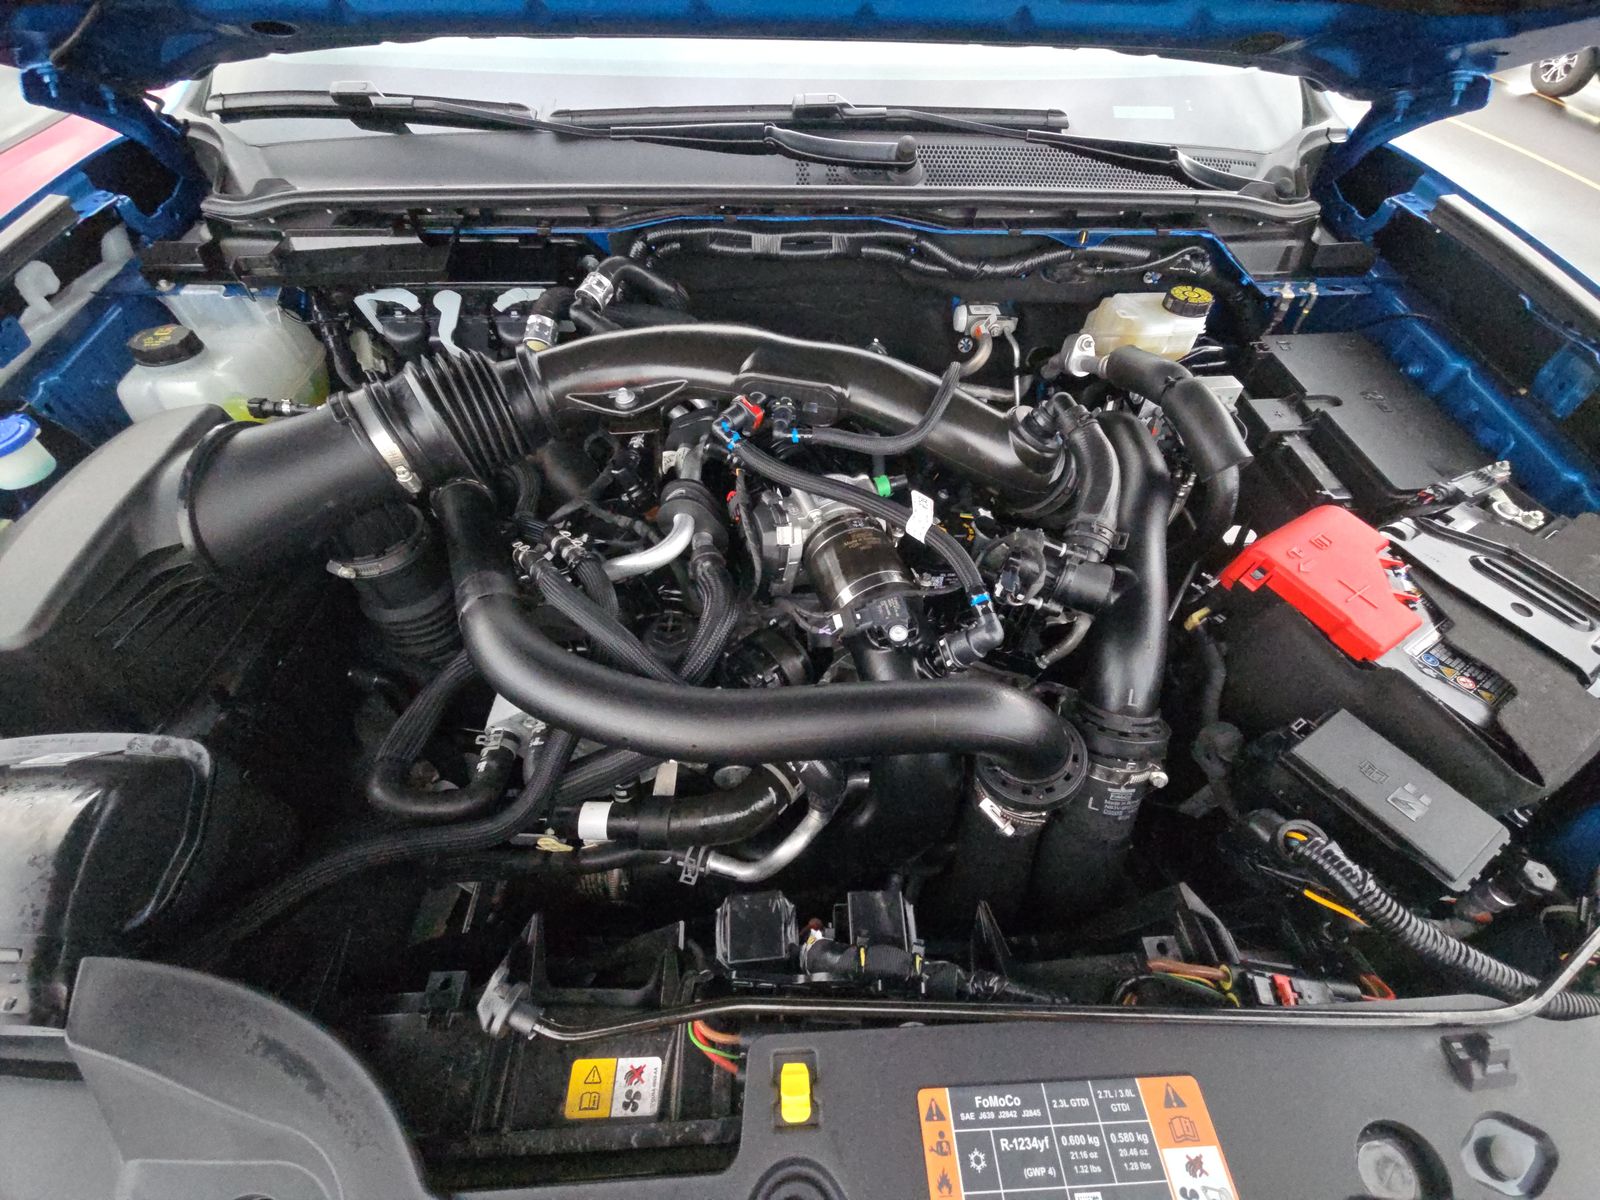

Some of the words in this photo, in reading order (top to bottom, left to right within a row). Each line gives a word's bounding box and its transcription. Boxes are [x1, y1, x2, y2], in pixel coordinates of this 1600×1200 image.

[1097, 1089, 1114, 1099] 2.7L
[974, 1094, 1022, 1108] FoMoCo
[1052, 1099, 1069, 1109] 2.3L
[1069, 1097, 1090, 1107] GTDI
[1110, 1103, 1131, 1112] GTDI
[960, 1112, 976, 1121] SAE
[978, 1111, 995, 1120] J639
[1061, 1134, 1086, 1146] 0.600
[1086, 1134, 1100, 1147] kg
[1110, 1132, 1135, 1143] 0.580
[1135, 1131, 1150, 1144] kg
[999, 1135, 1050, 1153] R-1234yf
[1070, 1151, 1088, 1160] 21.16
[1089, 1151, 1099, 1159] oz
[1118, 1148, 1139, 1157] 20.46
[1074, 1165, 1089, 1174] 1.32
[1089, 1164, 1102, 1173] lbs
[1124, 1162, 1139, 1171] 1.28
[1139, 1162, 1152, 1170] lbs
[1023, 1166, 1046, 1179] (GWP
[1047, 1166, 1057, 1178] 4)
